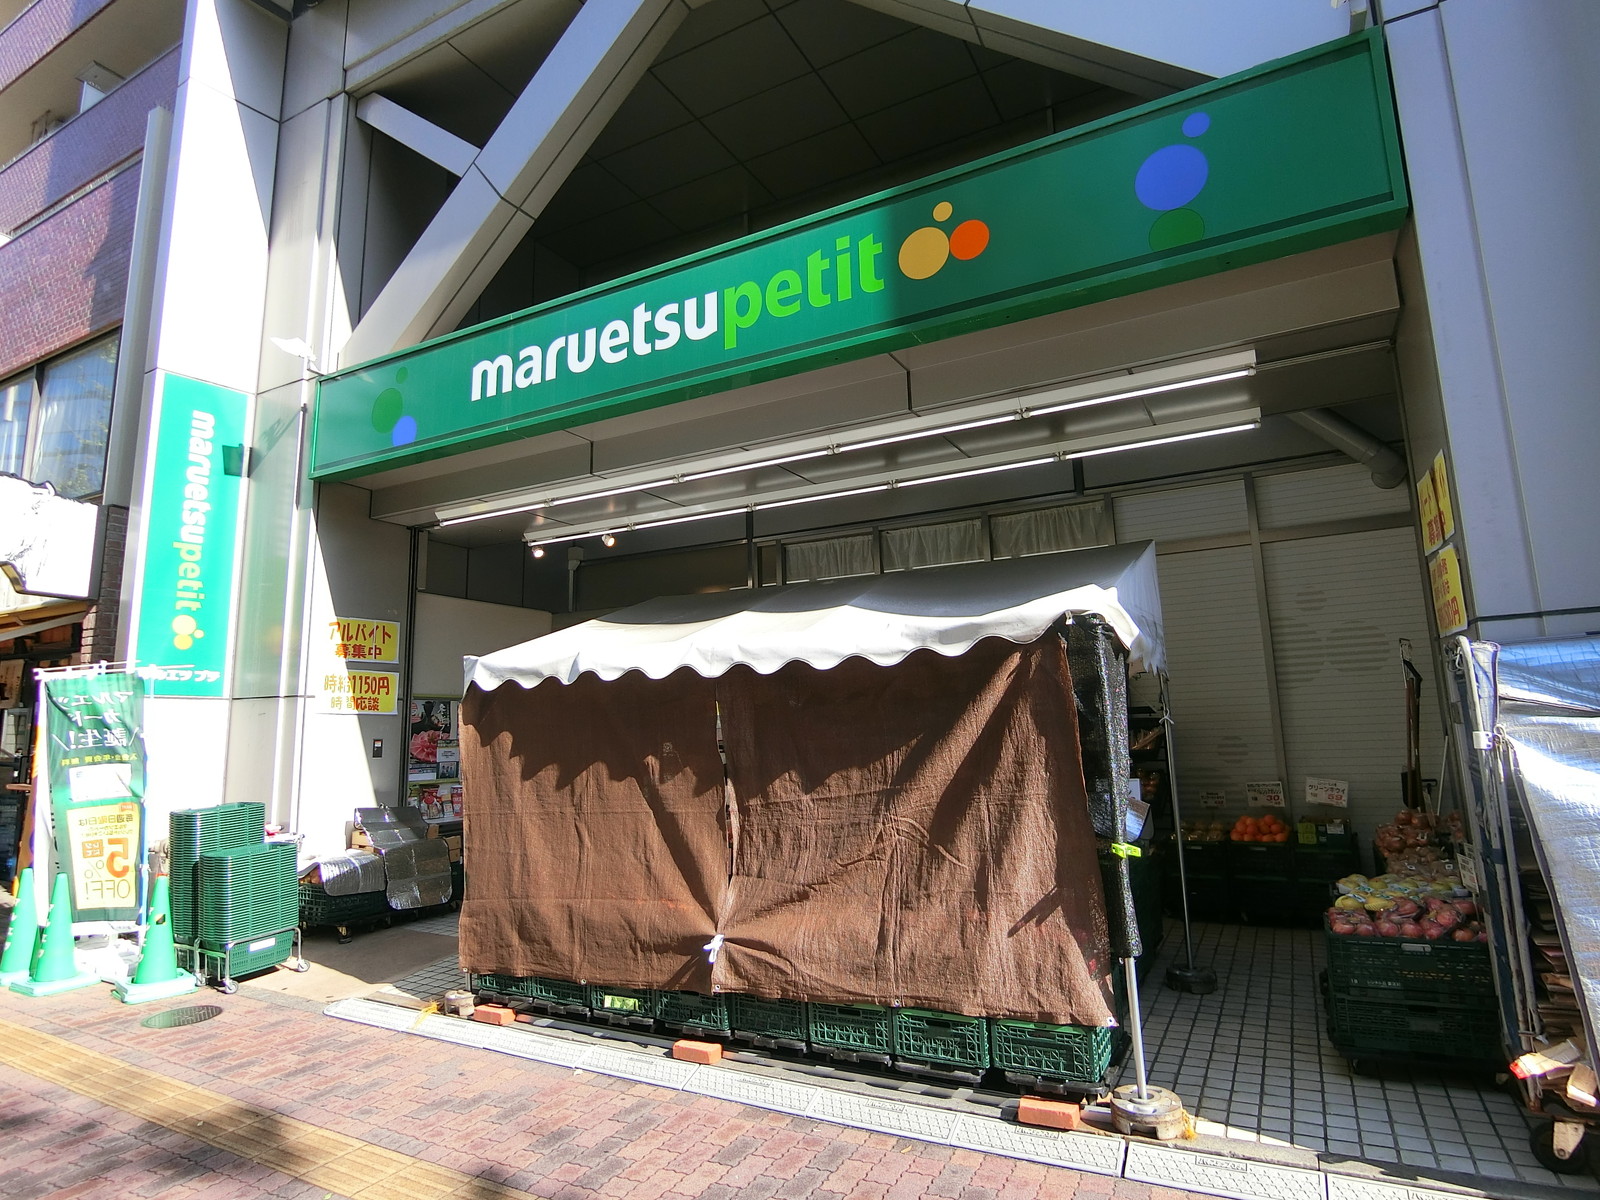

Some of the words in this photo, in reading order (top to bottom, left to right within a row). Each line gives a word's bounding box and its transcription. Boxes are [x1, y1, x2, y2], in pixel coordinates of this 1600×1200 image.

[329, 622, 392, 644] アルバイト
[335, 643, 383, 660] 募集中
[324, 674, 390, 696] 時給1150円
